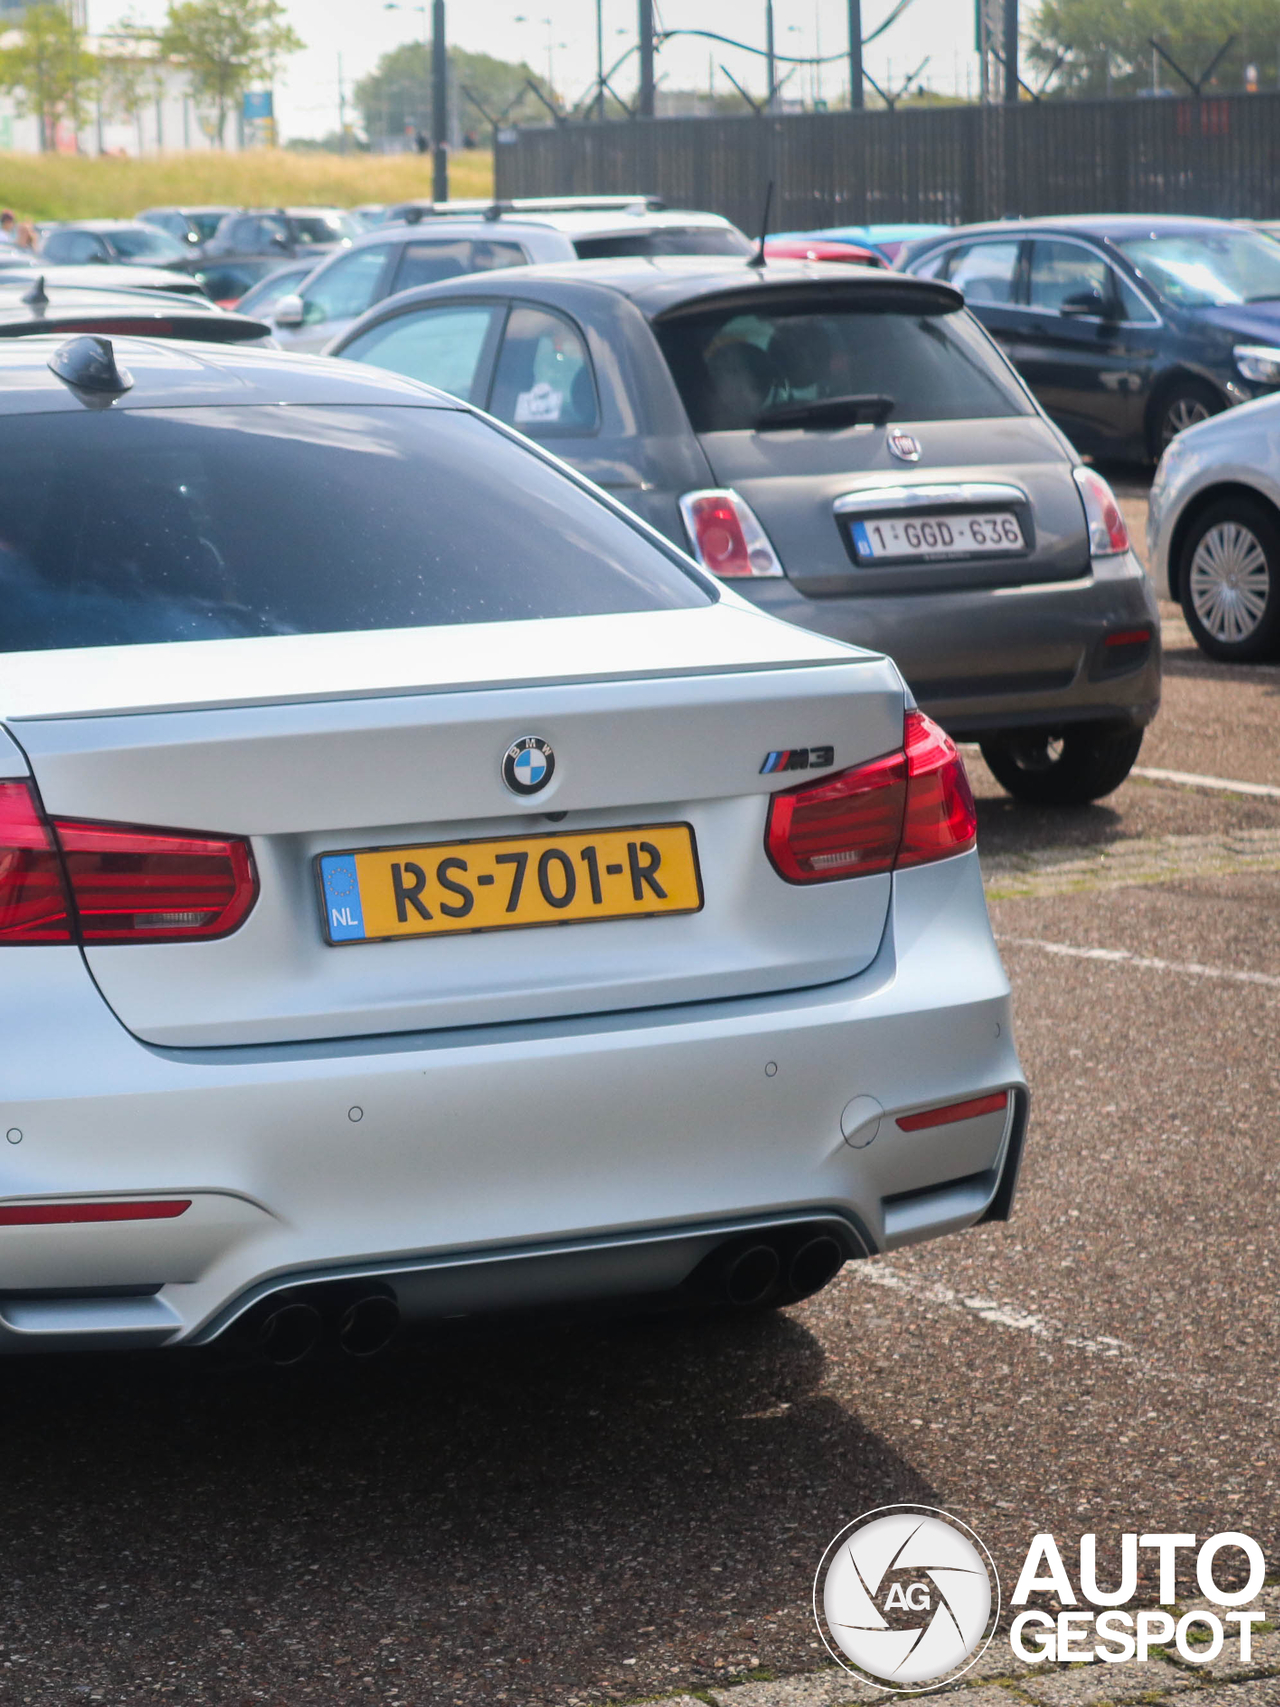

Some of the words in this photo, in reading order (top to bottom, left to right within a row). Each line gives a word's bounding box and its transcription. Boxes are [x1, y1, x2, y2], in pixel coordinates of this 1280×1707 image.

[508, 738, 553, 758] BMW
[781, 745, 835, 772] M3
[390, 841, 668, 923] RS-701-R
[331, 907, 358, 927] NL
